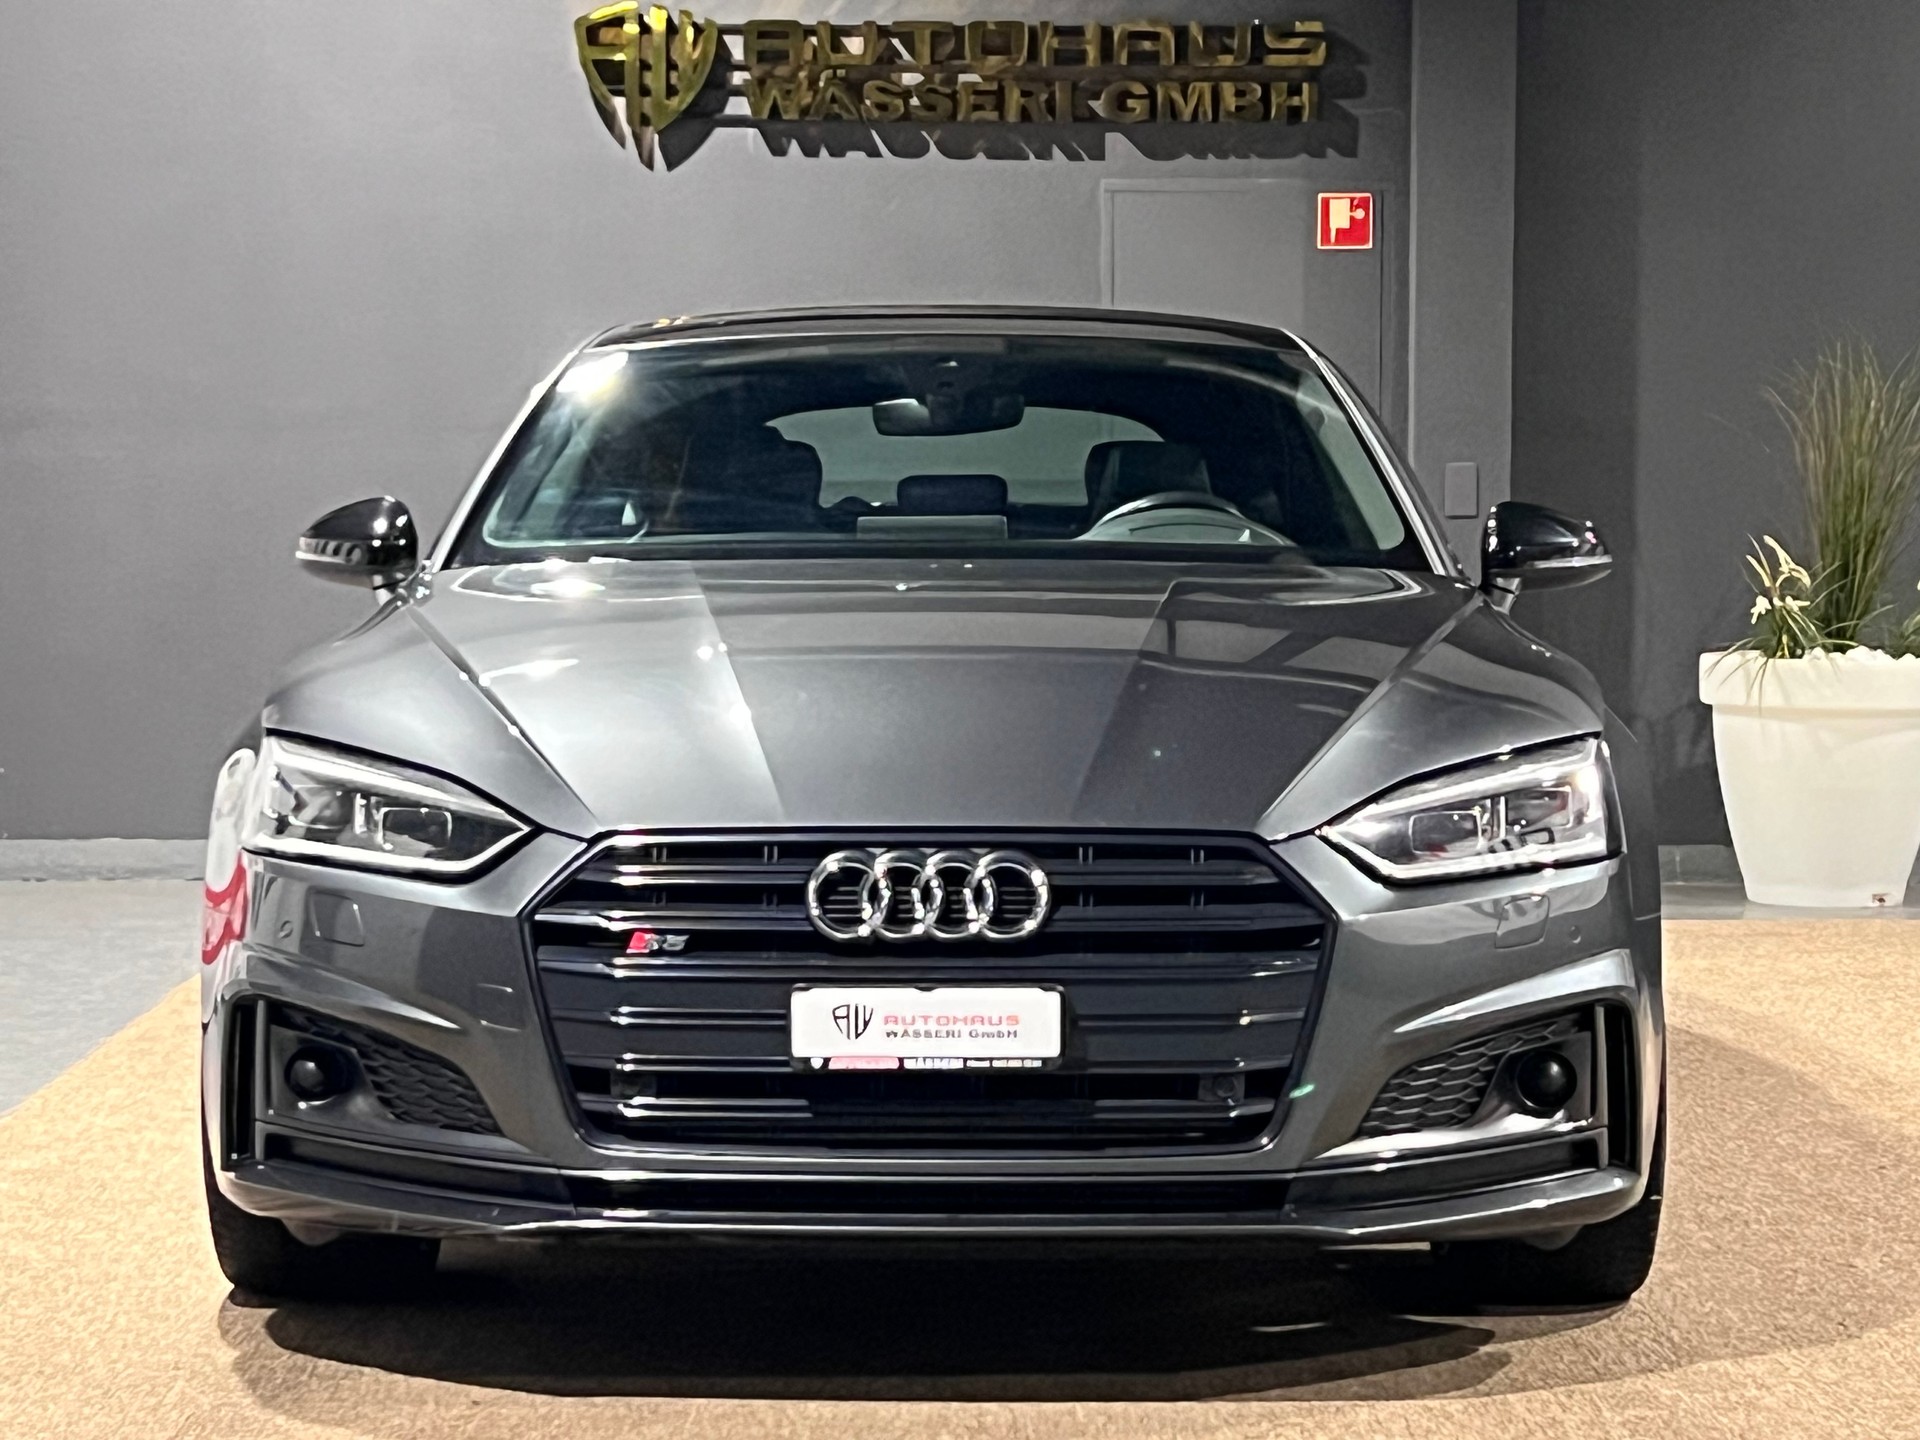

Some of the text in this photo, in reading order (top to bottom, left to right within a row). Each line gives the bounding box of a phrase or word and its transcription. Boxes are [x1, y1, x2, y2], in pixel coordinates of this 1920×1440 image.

[743, 19, 1326, 66] AUTOHAUS
[1100, 81, 1318, 123] GMBH
[883, 1015, 1020, 1026] AUTOHAUS
